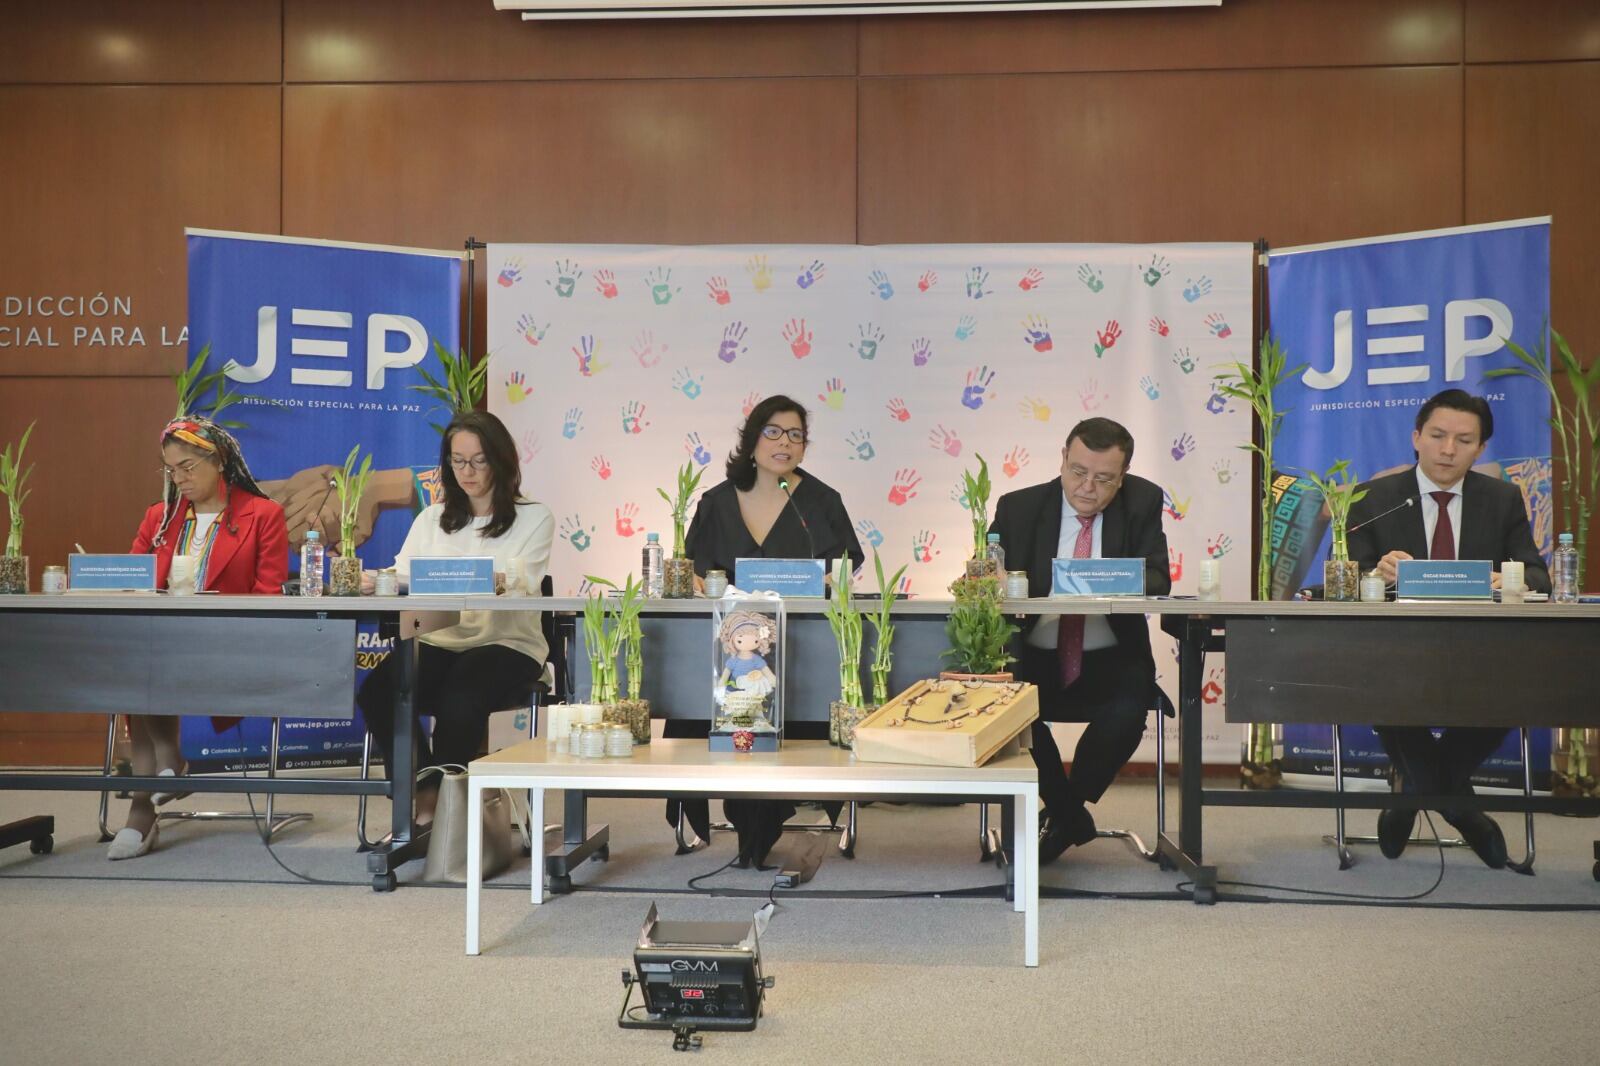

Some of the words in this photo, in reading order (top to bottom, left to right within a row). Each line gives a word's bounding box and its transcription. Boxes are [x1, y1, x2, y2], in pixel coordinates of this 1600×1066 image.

[74, 327, 146, 346] PARA
[1301, 298, 1513, 390] JEP
[223, 306, 429, 390] JEP
[308, 400, 355, 410] ESPECIAL
[359, 402, 383, 411] PARA
[386, 404, 398, 412] LA
[402, 404, 420, 413] PAZ
[1310, 399, 1380, 412] JURISDICCIÓN
[1384, 396, 1430, 408] ESPECIA
[1486, 393, 1505, 402] PAZ
[285, 720, 352, 729] www.jep.gov.co
[211, 747, 248, 755] ColombiaJP
[671, 960, 718, 971] GVM
